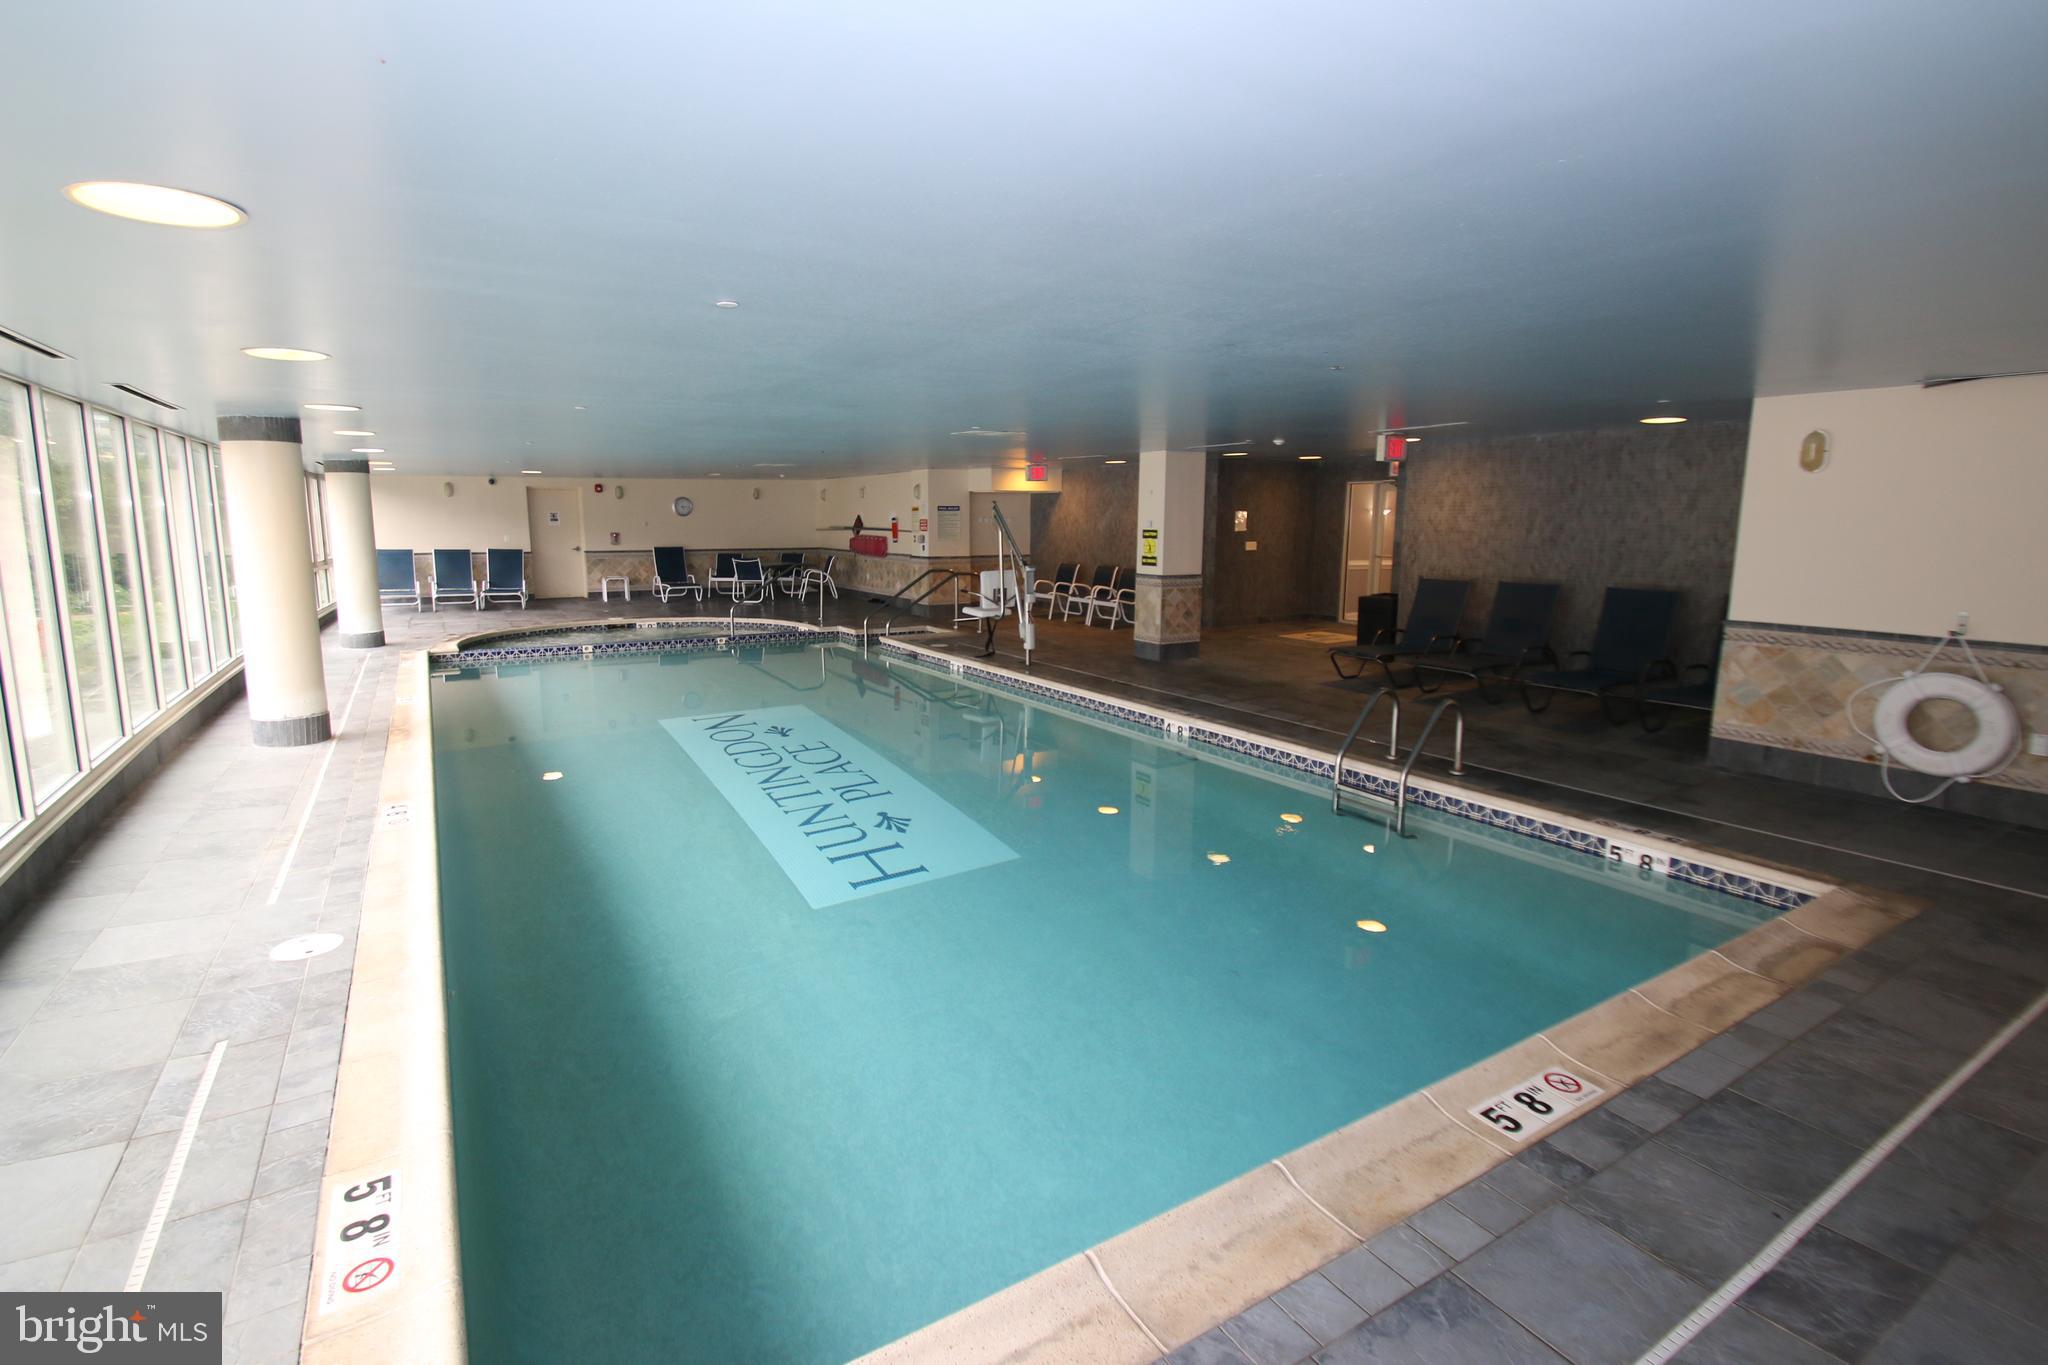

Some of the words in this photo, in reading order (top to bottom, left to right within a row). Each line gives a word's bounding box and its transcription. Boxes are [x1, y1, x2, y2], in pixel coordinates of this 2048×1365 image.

[781, 740, 893, 804] PLACE
[691, 713, 930, 890] HUNTINGDON
[1610, 845, 1622, 862] 5
[1639, 854, 1653, 871] 8
[1513, 1091, 1553, 1116] 8
[1525, 1084, 1545, 1097] IN
[1479, 1106, 1523, 1133] 5
[1494, 1100, 1513, 1113] FT
[343, 1175, 392, 1203] 5
[375, 1191, 392, 1206] FT
[339, 1213, 391, 1242] 8
[372, 1230, 391, 1248] IN
